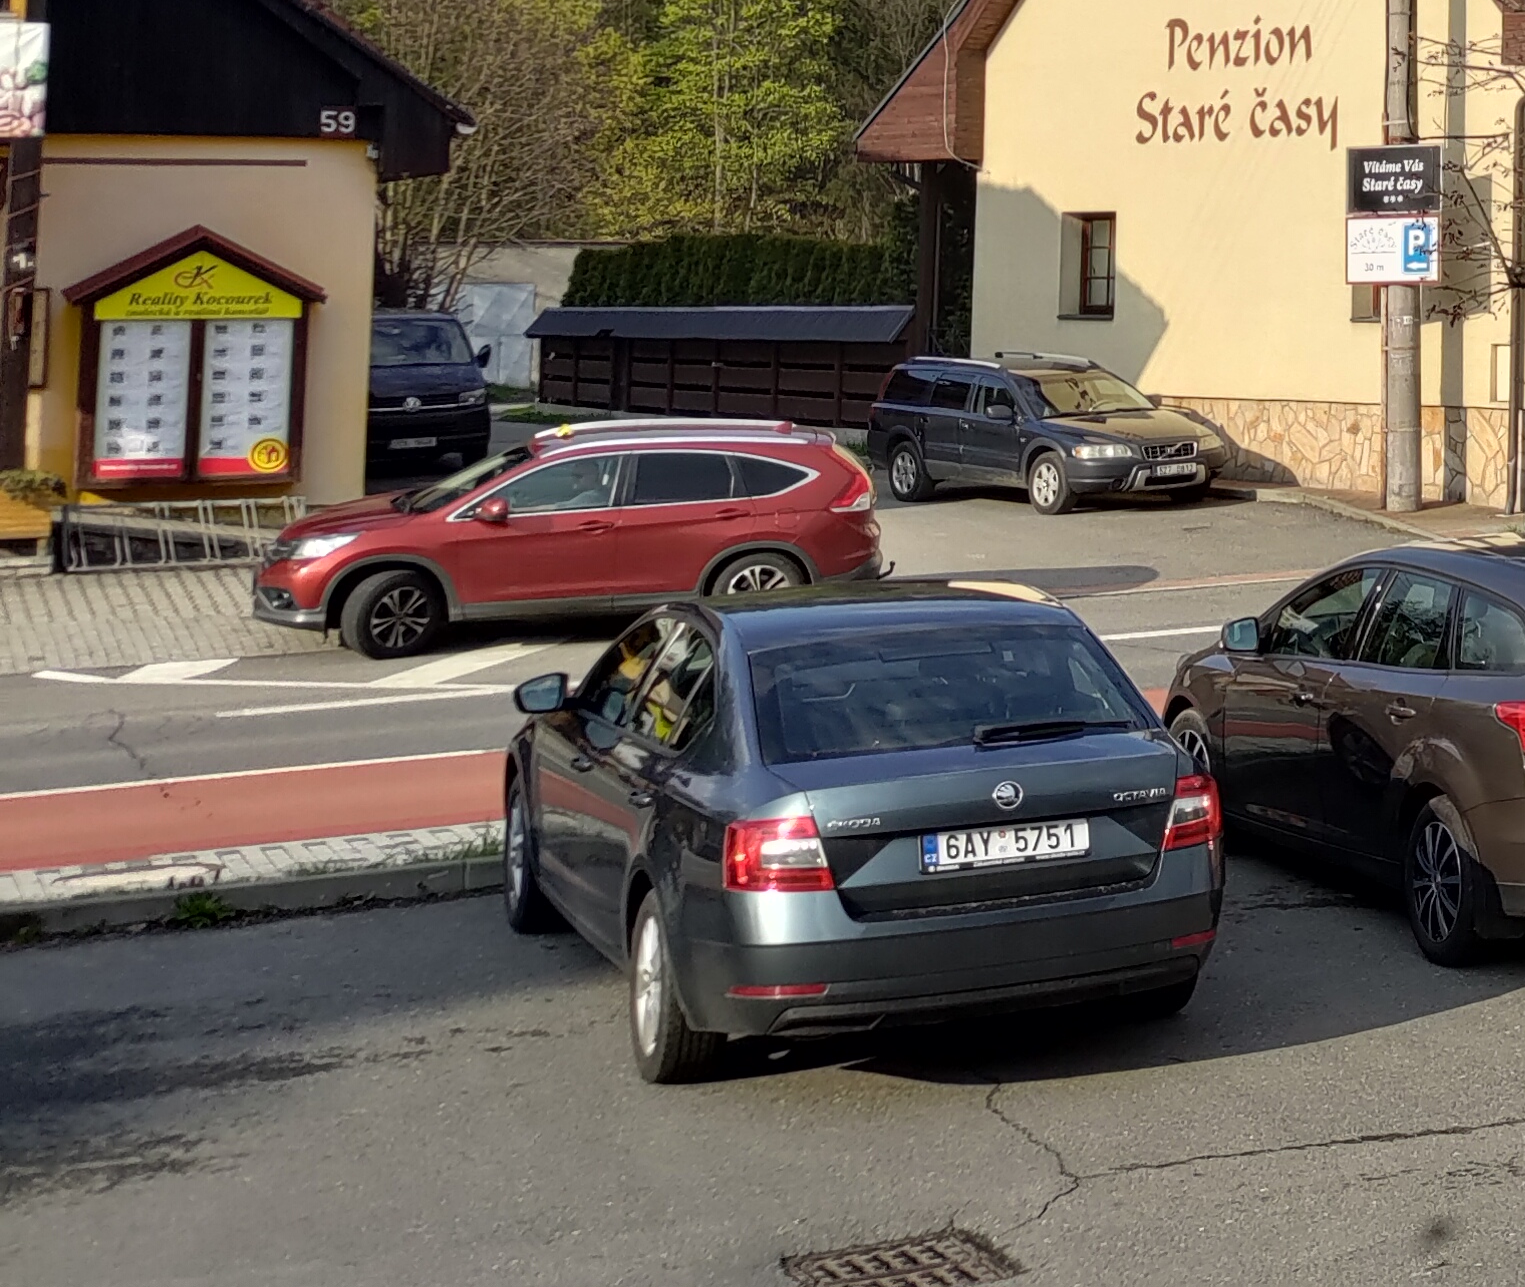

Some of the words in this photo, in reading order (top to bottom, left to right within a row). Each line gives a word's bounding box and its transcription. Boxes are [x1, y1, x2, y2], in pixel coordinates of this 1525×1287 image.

[1165, 14, 1313, 72] Penzion
[320, 110, 356, 133] 59
[1135, 89, 1231, 144] Staré
[1250, 87, 1339, 151] časy
[1403, 159, 1424, 172] Vás
[1362, 176, 1395, 192] Staré
[1396, 176, 1423, 194] časy
[1408, 229, 1426, 256] P
[129, 292, 189, 309] Reality
[193, 292, 273, 305] Kocourek
[1113, 787, 1166, 802] OCTAVIA
[945, 831, 992, 860] 6AY
[1013, 823, 1075, 853] 5751
[924, 853, 937, 863] CZ
